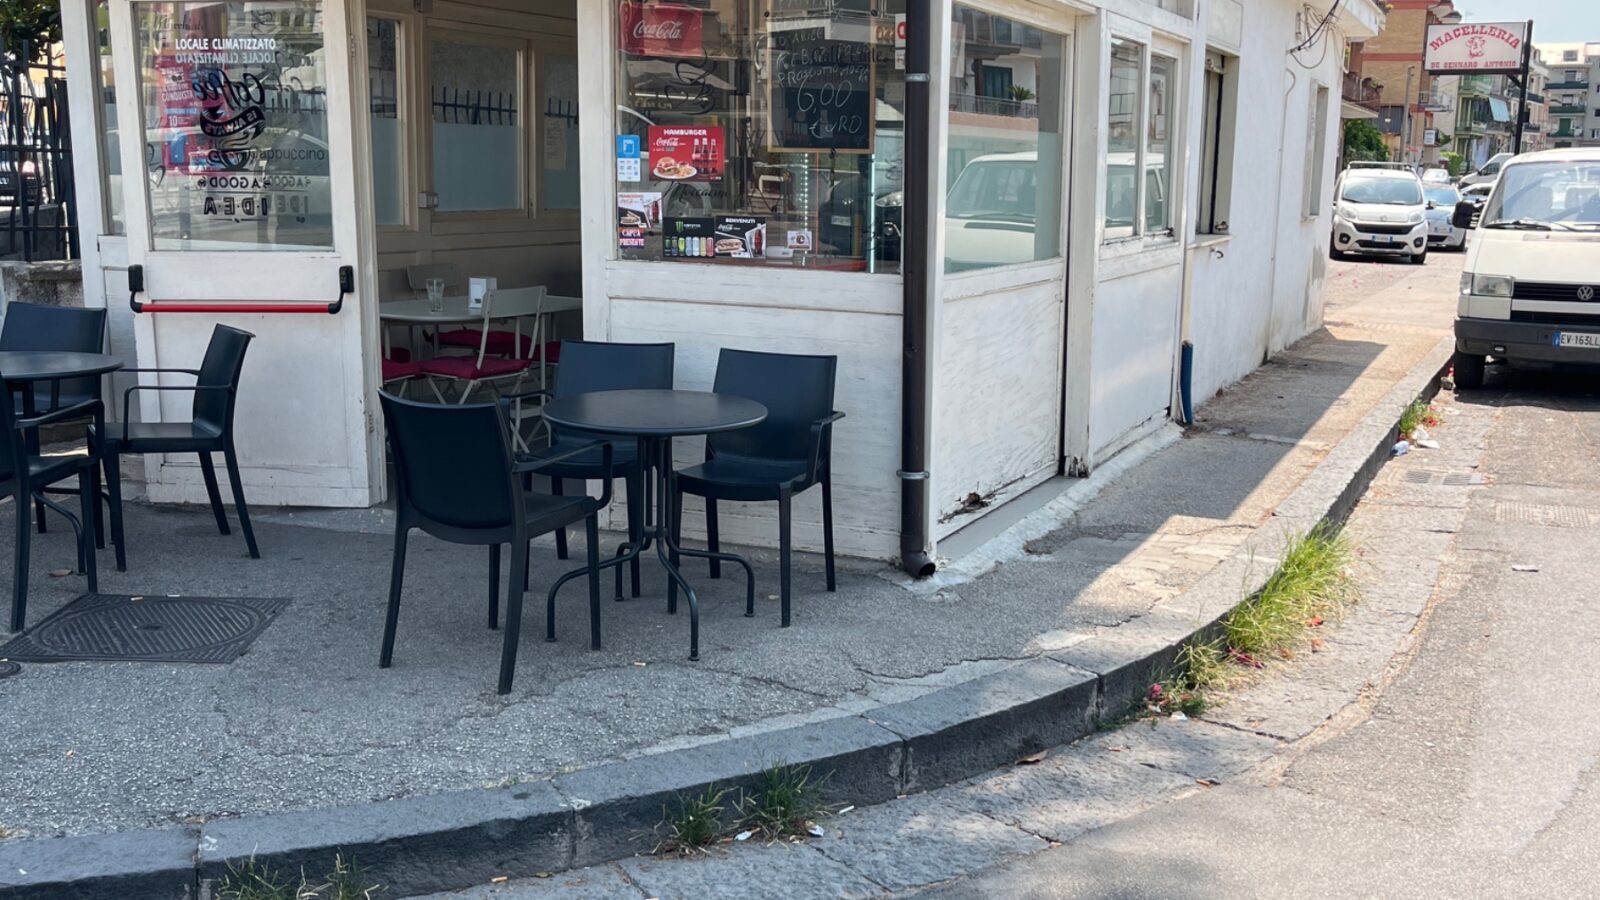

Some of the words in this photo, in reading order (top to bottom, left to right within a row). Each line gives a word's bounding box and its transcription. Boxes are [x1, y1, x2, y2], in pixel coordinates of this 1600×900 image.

[175, 38, 209, 50] LOCALE
[213, 38, 276, 50] CLIMATIZZATO
[1429, 25, 1521, 51] MACELLERIA
[663, 128, 707, 136] HAMBURGER
